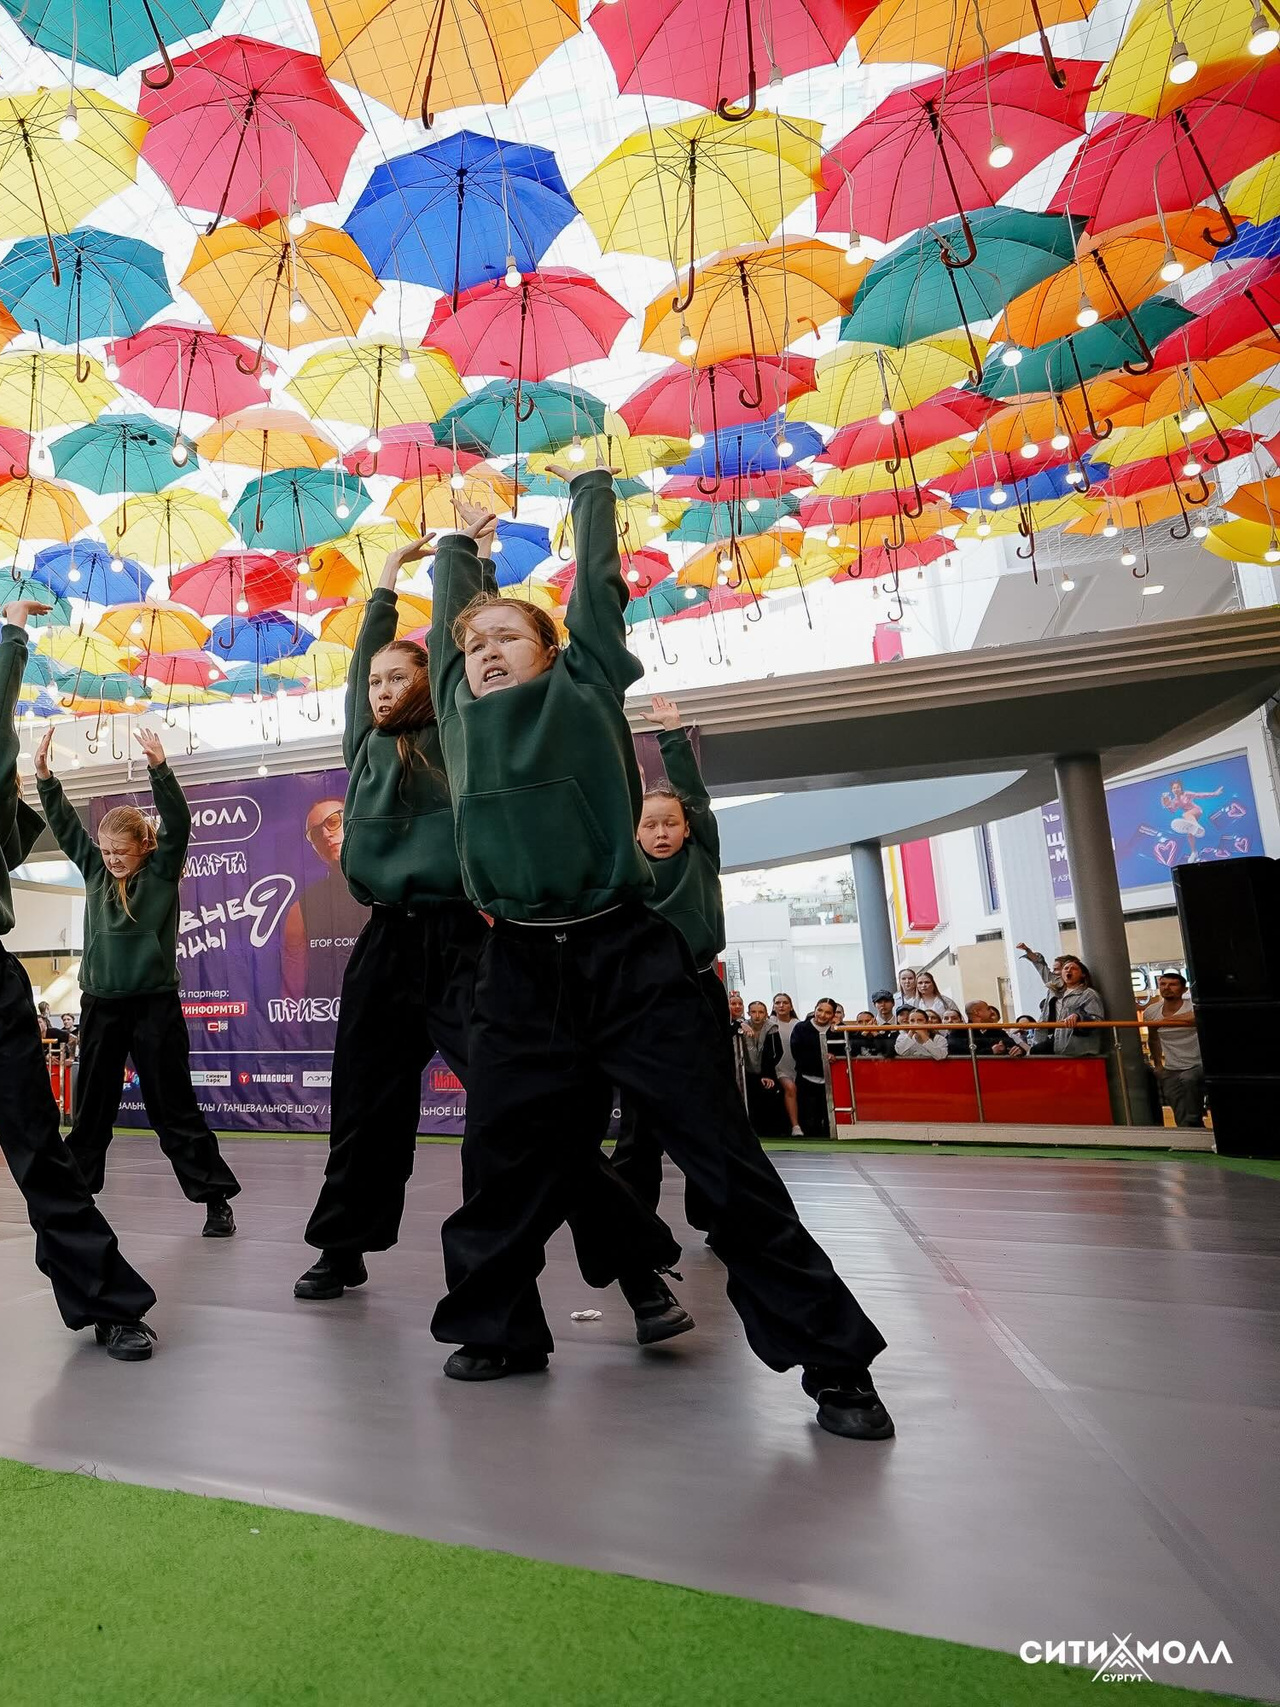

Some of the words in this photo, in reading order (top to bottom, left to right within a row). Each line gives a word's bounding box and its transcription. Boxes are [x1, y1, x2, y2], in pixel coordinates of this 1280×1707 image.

[310, 938, 332, 948] ЕГОР
[187, 989, 229, 999] партнер:
[252, 1074, 294, 1083] YAMAGUCHI
[223, 1103, 293, 1113] ТАНЦЕВАЛЬНОЕ
[295, 1104, 319, 1114] ШОУ
